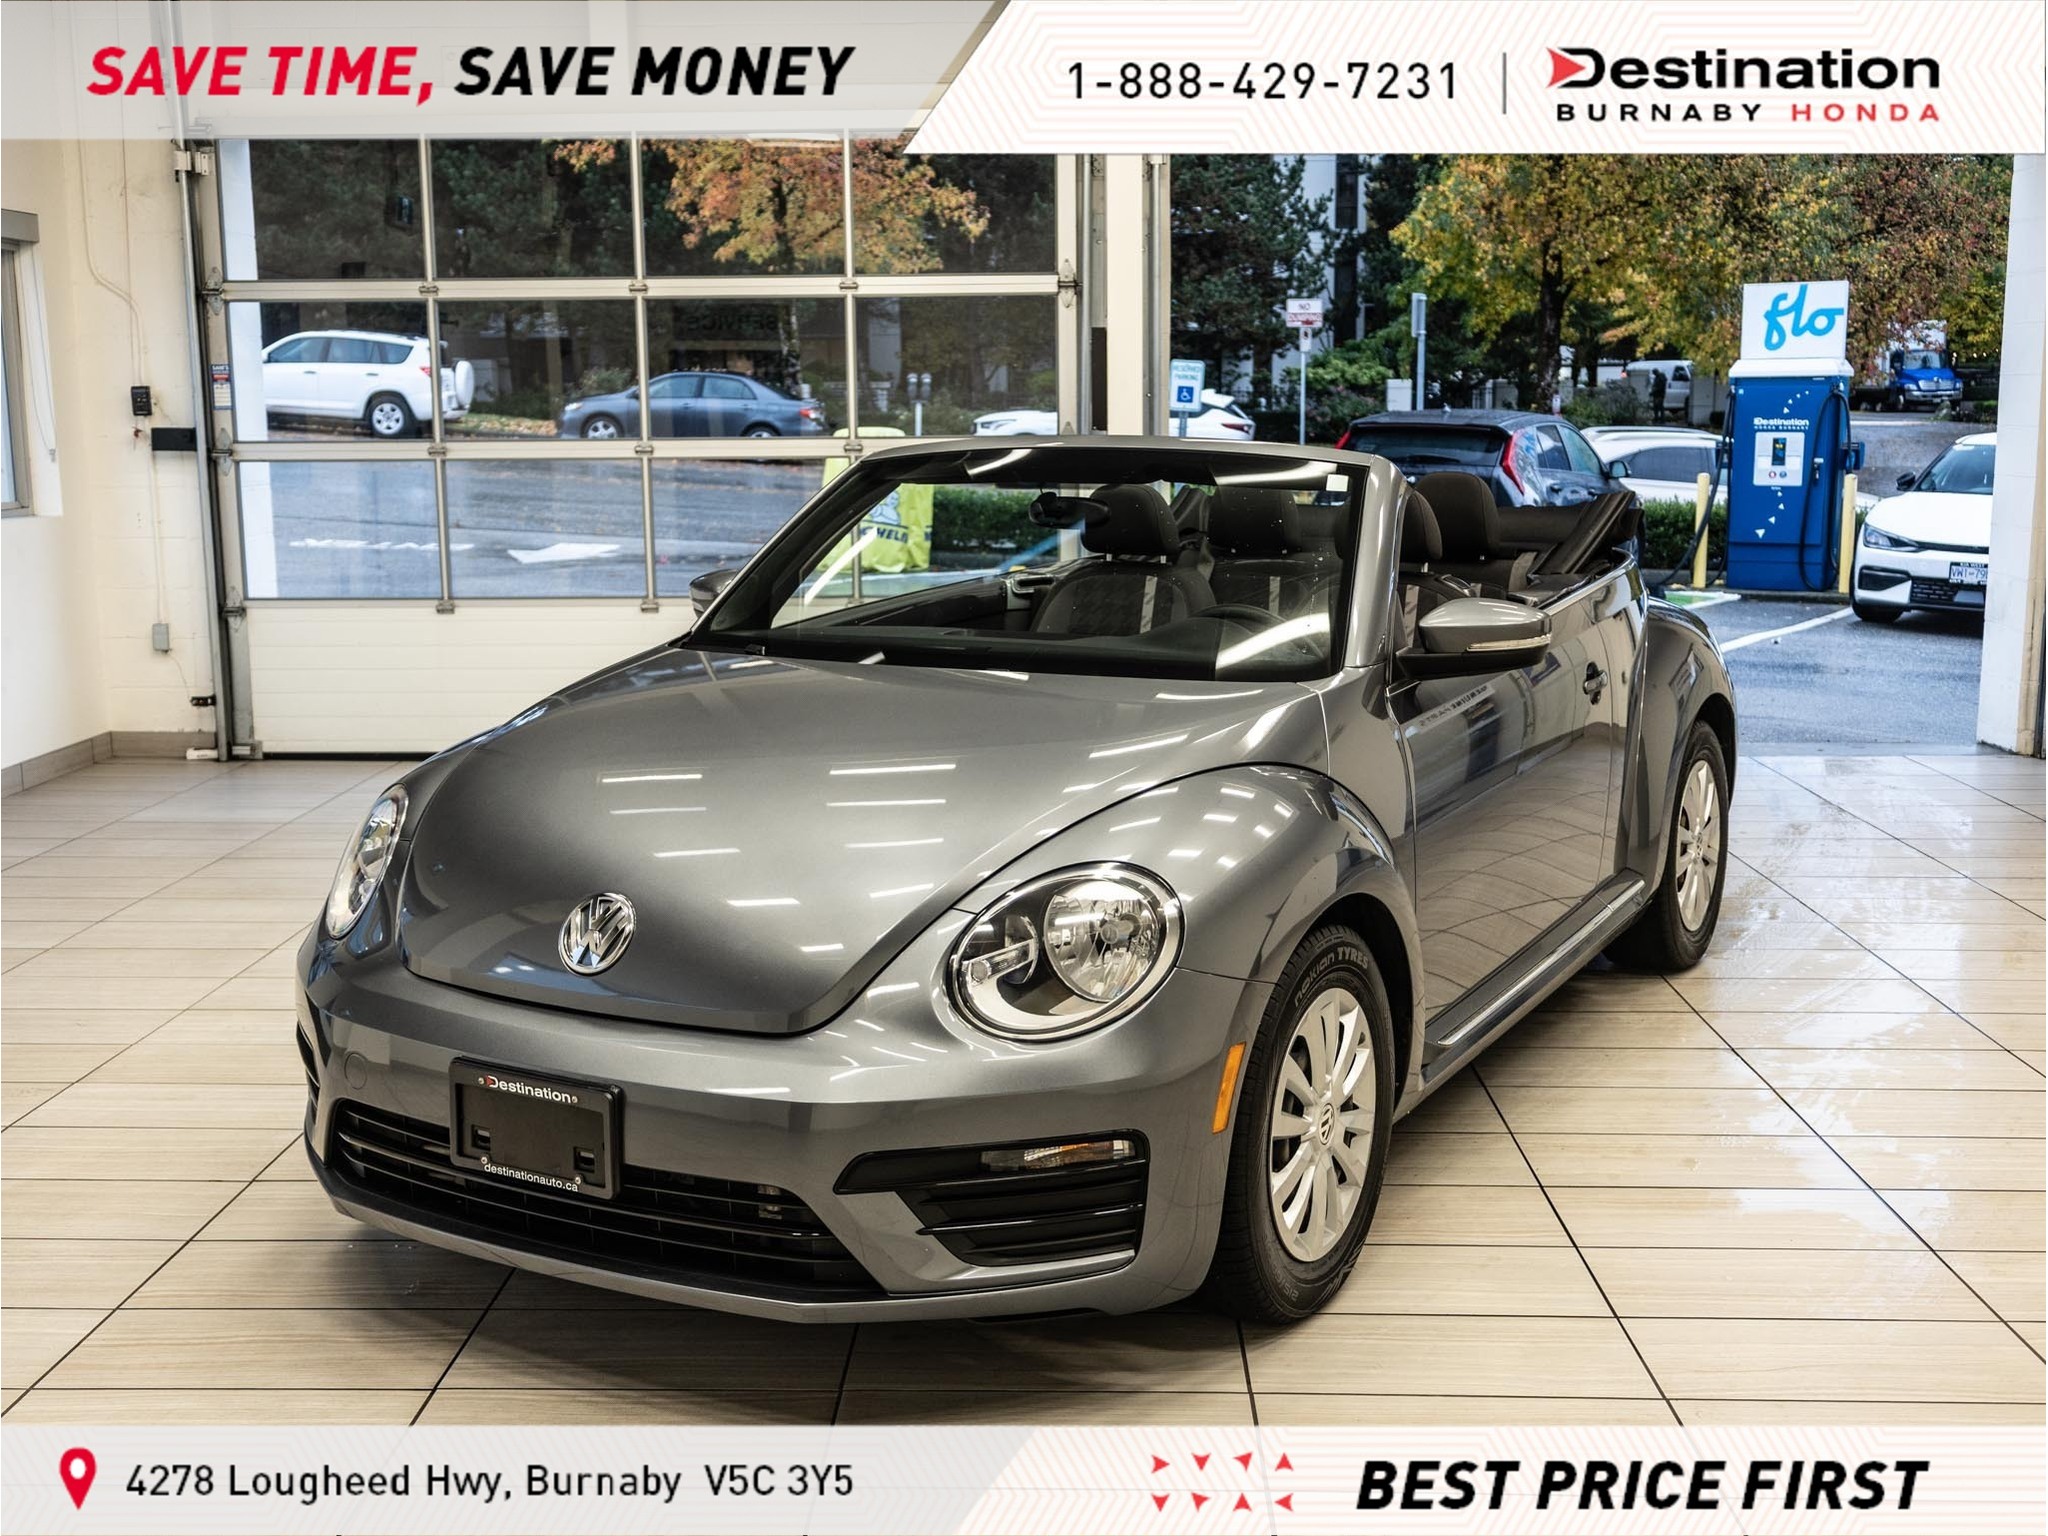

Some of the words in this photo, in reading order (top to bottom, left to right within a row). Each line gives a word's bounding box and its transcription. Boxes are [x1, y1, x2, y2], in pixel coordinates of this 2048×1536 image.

[1763, 284, 1844, 351] flo
[1753, 417, 1809, 426] Destination
[1337, 946, 1369, 970] TYRES
[486, 1075, 572, 1104] Destination
[484, 1163, 579, 1192] destinationauto.ca
